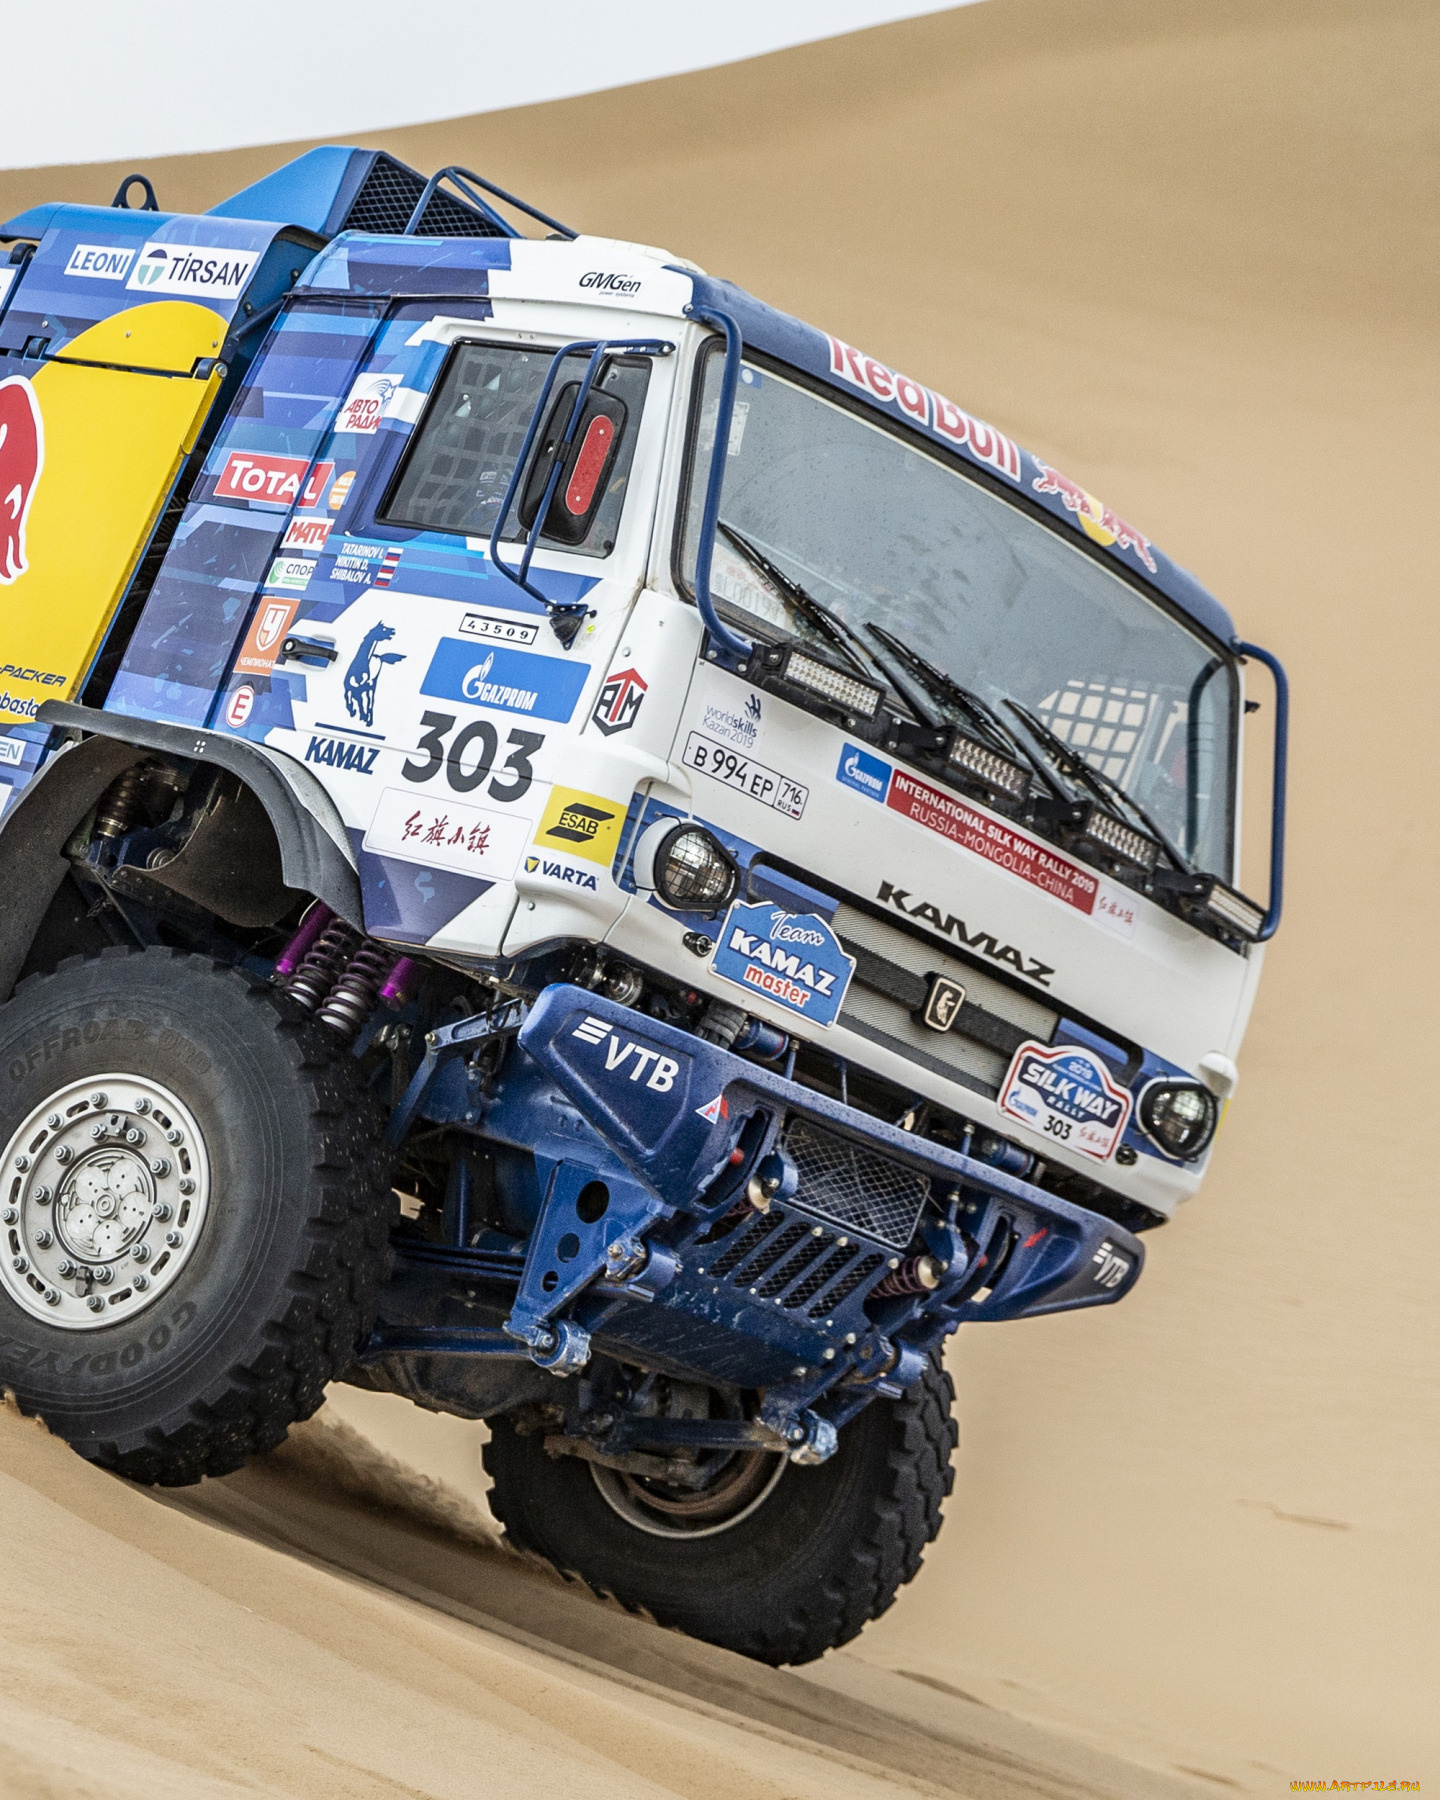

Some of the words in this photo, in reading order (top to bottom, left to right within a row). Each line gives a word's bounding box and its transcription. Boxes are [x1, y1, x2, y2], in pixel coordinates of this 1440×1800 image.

[70, 250, 130, 275] LEONI
[579, 271, 641, 292] GMGen
[229, 459, 317, 500] TOTAL
[231, 693, 250, 721] E
[479, 684, 538, 711] GAZPROM
[702, 714, 731, 739] Kazan
[729, 729, 754, 749] 2019
[706, 704, 757, 738] worldskills
[304, 735, 381, 775] KAMAZ
[401, 710, 546, 802] 303
[711, 748, 748, 788] 994
[777, 800, 791, 812] RUS
[781, 782, 803, 806] 716
[558, 812, 599, 835] ESAB
[895, 775, 986, 835] INTERNATIONAL
[986, 824, 1012, 848] SILK
[1013, 838, 1039, 861] WAY
[1038, 852, 1072, 880] RALLY
[1071, 871, 1095, 894] 2019
[541, 860, 597, 892] VARTA
[770, 910, 825, 947] Team
[876, 880, 1056, 987] KAMAZ
[728, 926, 838, 998] KAMAZ
[743, 963, 811, 1008] master
[605, 1035, 680, 1093] VTB
[1021, 1062, 1078, 1100] SILK
[1072, 1085, 1119, 1120] WAY
[1043, 1114, 1072, 1140] 303
[1093, 1254, 1130, 1288] VTB
